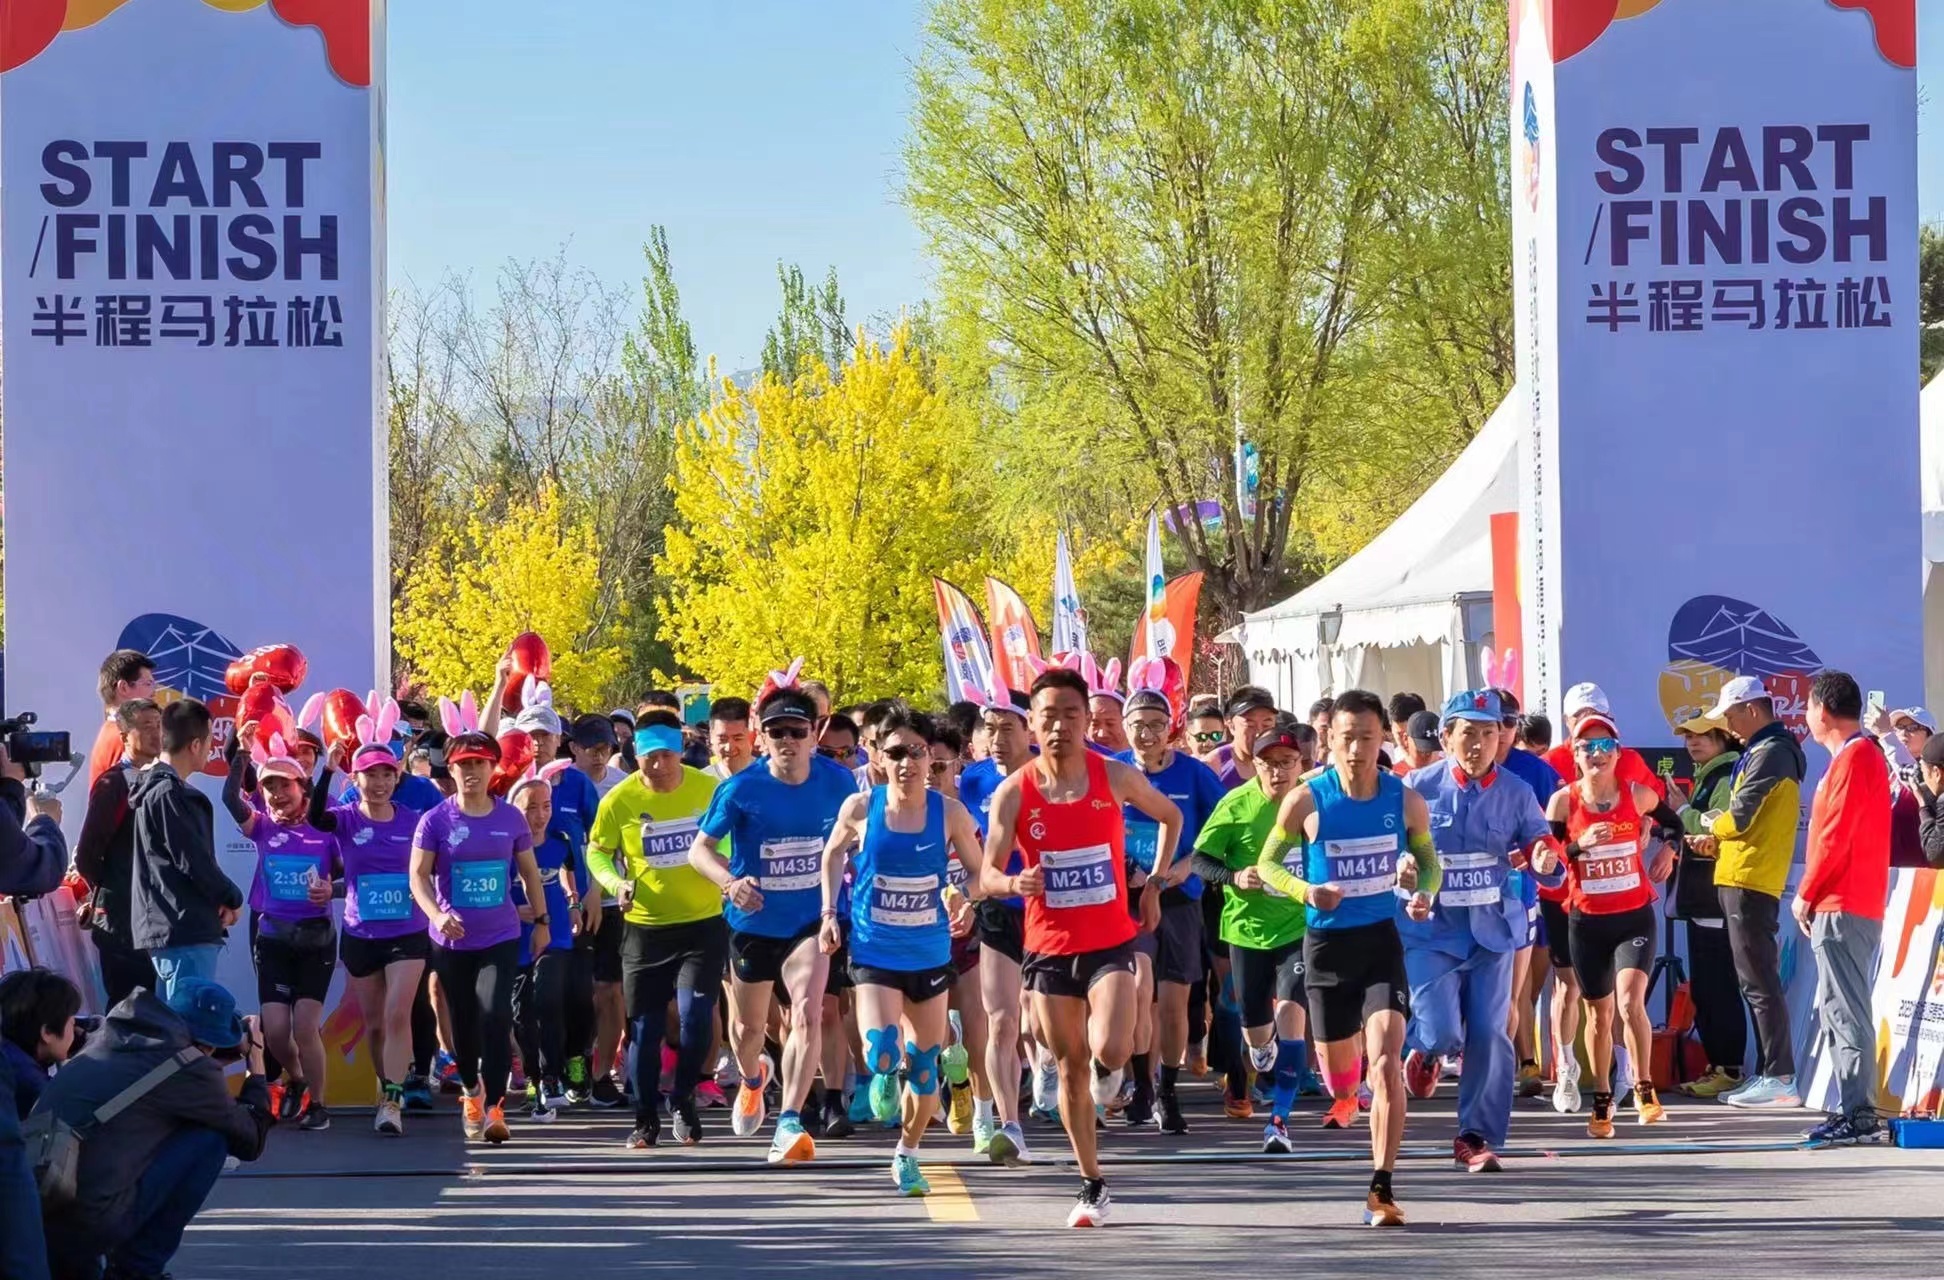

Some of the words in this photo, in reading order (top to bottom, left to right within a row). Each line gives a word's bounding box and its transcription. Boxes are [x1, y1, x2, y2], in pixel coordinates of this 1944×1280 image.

[1594, 123, 1870, 195] START
[40, 139, 321, 208] START
[1584, 196, 1888, 267] /FINISH
[29, 213, 339, 282] /FINISH
[1586, 276, 1893, 333] 半程马拉松
[31, 294, 344, 347] 半程马拉松
[651, 833, 693, 853] M130
[769, 856, 817, 875] M435
[1337, 855, 1390, 877] M414
[1586, 858, 1632, 877] F1131
[273, 871, 308, 886] 2:30
[461, 877, 498, 893] 2:30
[1051, 865, 1105, 889] M215
[1447, 870, 1492, 888] M306
[368, 890, 403, 905] 2:00
[880, 892, 930, 909] M472
